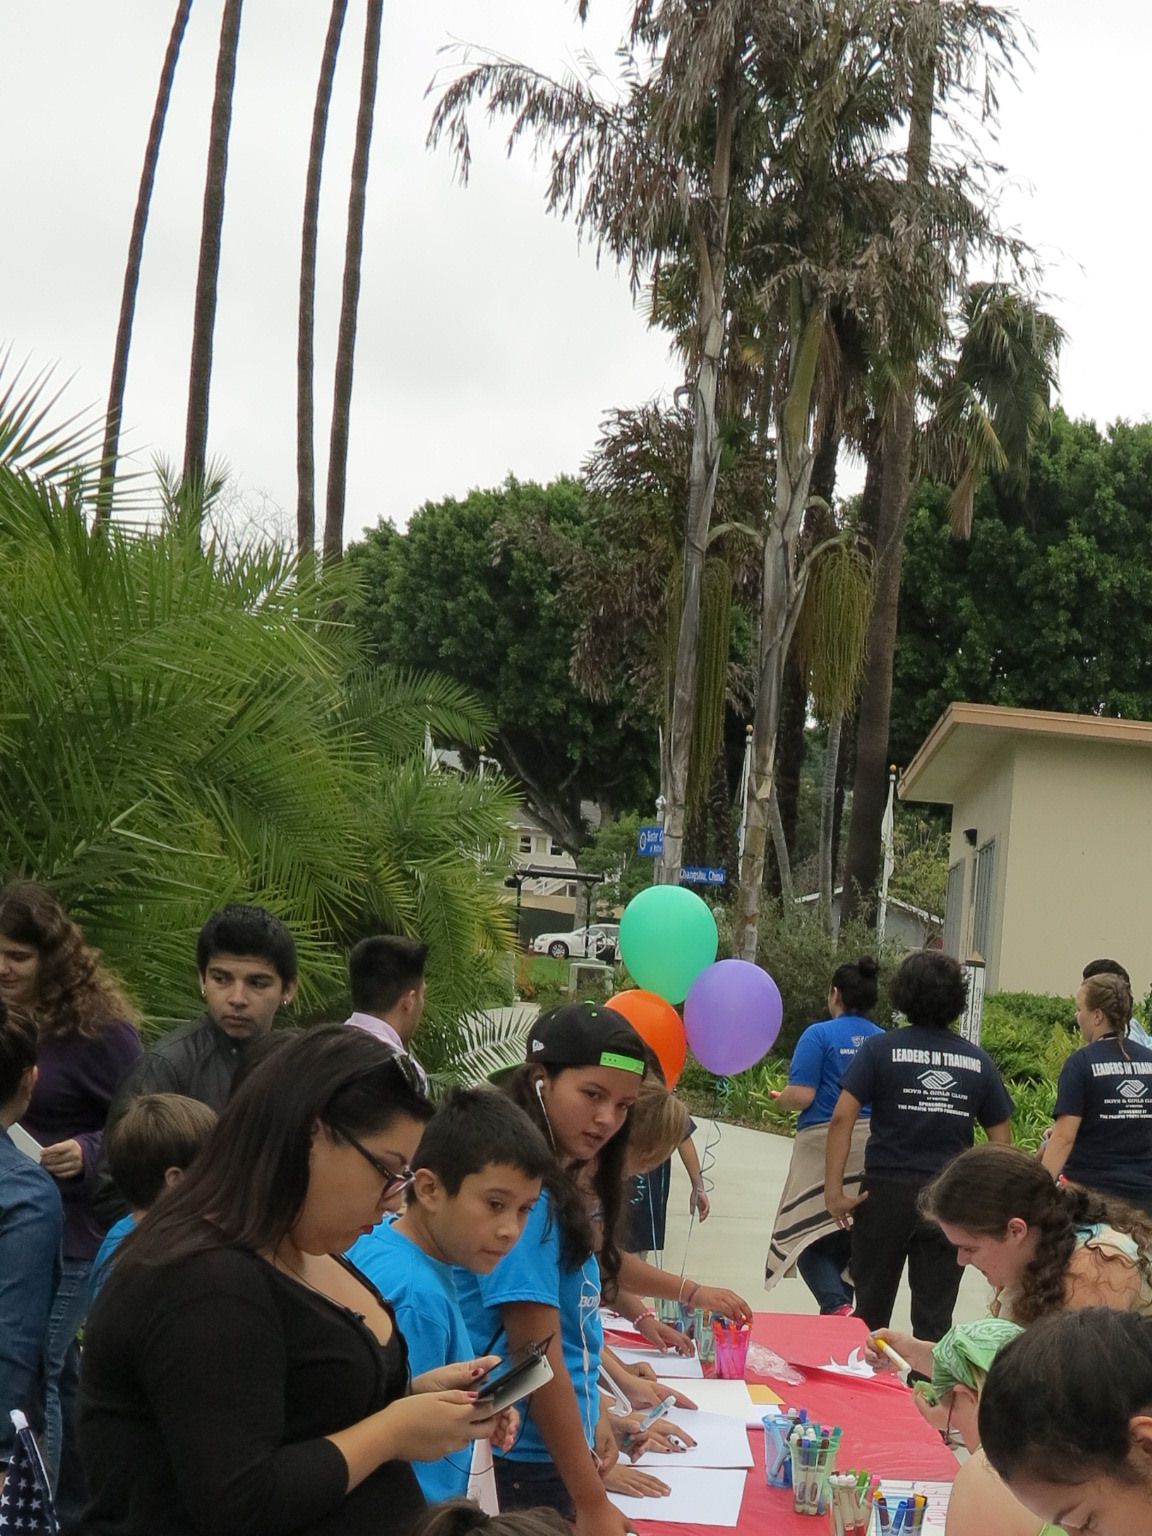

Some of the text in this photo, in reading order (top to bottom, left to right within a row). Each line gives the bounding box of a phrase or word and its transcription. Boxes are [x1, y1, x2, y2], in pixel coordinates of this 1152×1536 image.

[709, 871, 723, 882] China
[892, 1048, 981, 1074] LEADERS IN TRAINING
[1091, 1062, 1124, 1077] LEADERS
[1124, 1062, 1132, 1075] IN
